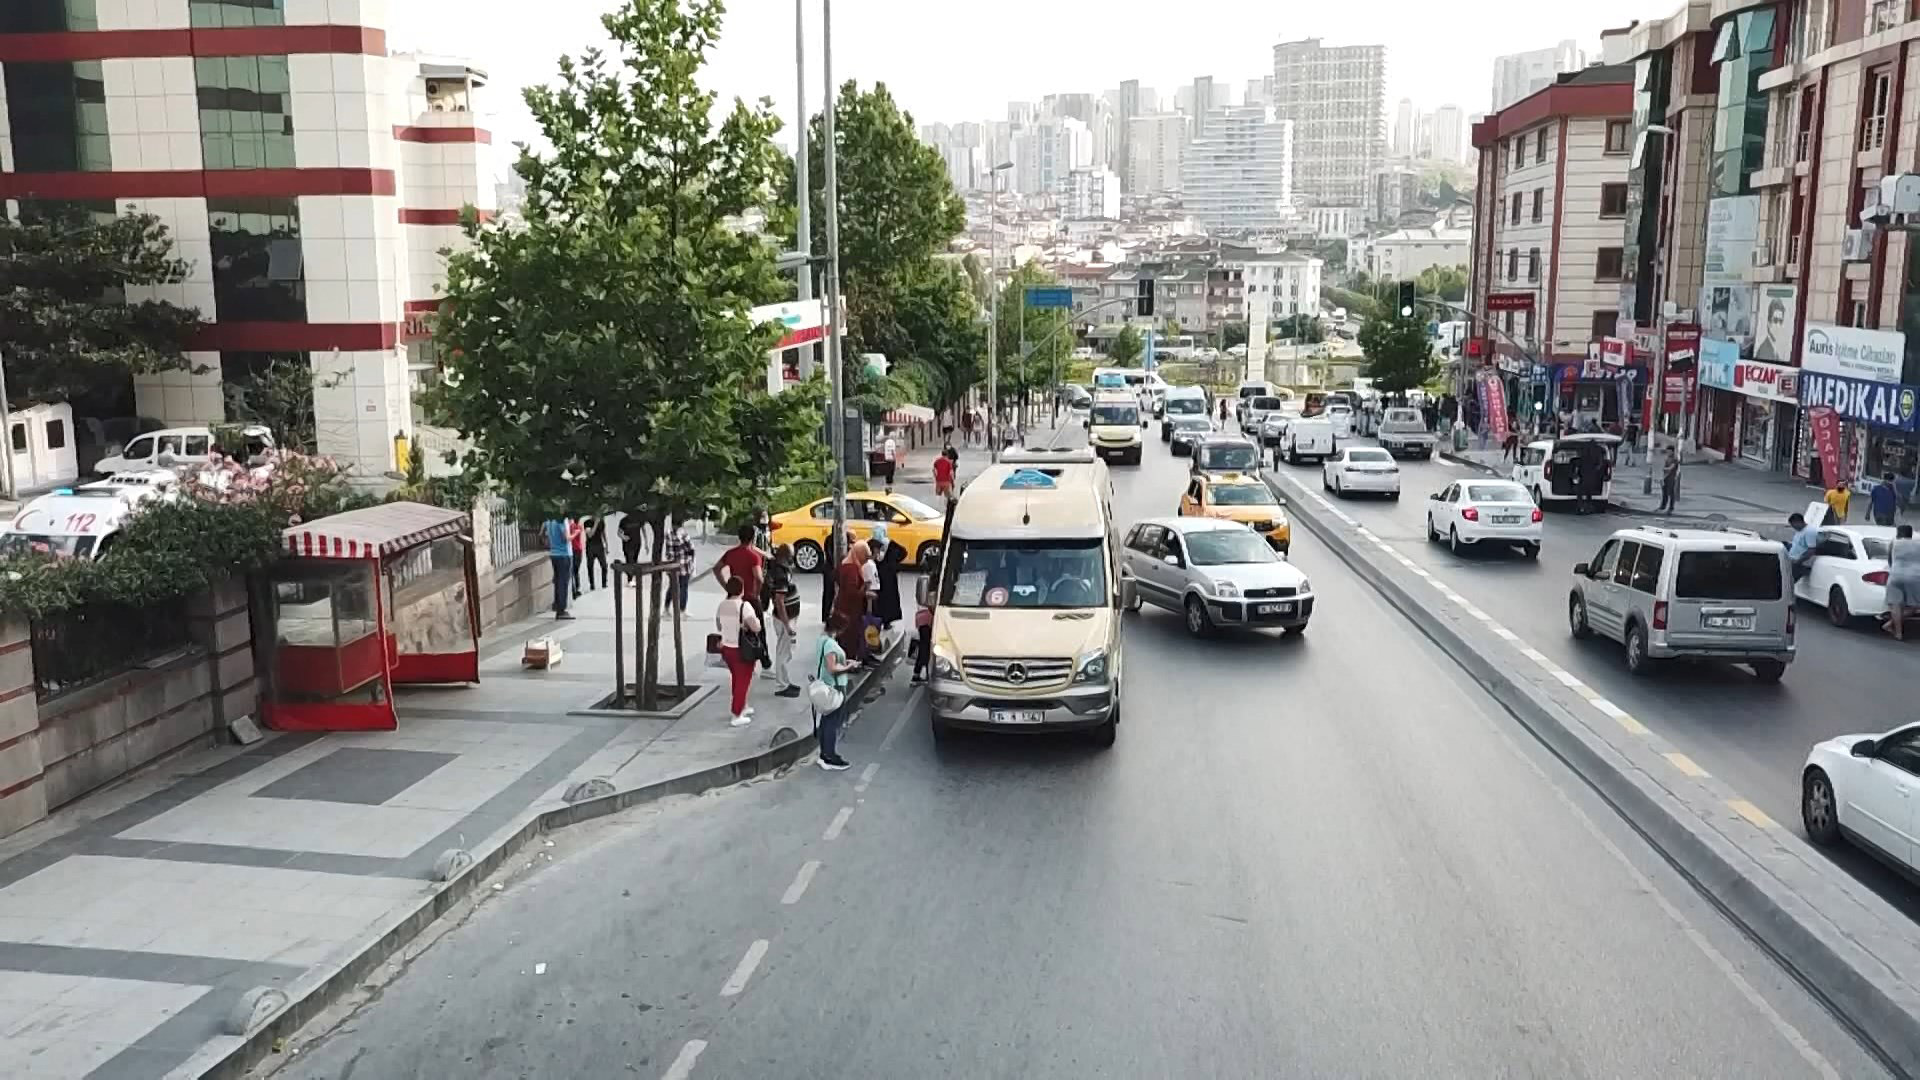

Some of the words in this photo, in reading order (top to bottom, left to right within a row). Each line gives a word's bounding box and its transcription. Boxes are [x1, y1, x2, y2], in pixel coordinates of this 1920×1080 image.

[1809, 339, 1833, 356] Auris
[1745, 365, 1778, 385] ECZAN
[1808, 375, 1900, 425] MEDİKAL
[65, 513, 97, 532] 112
